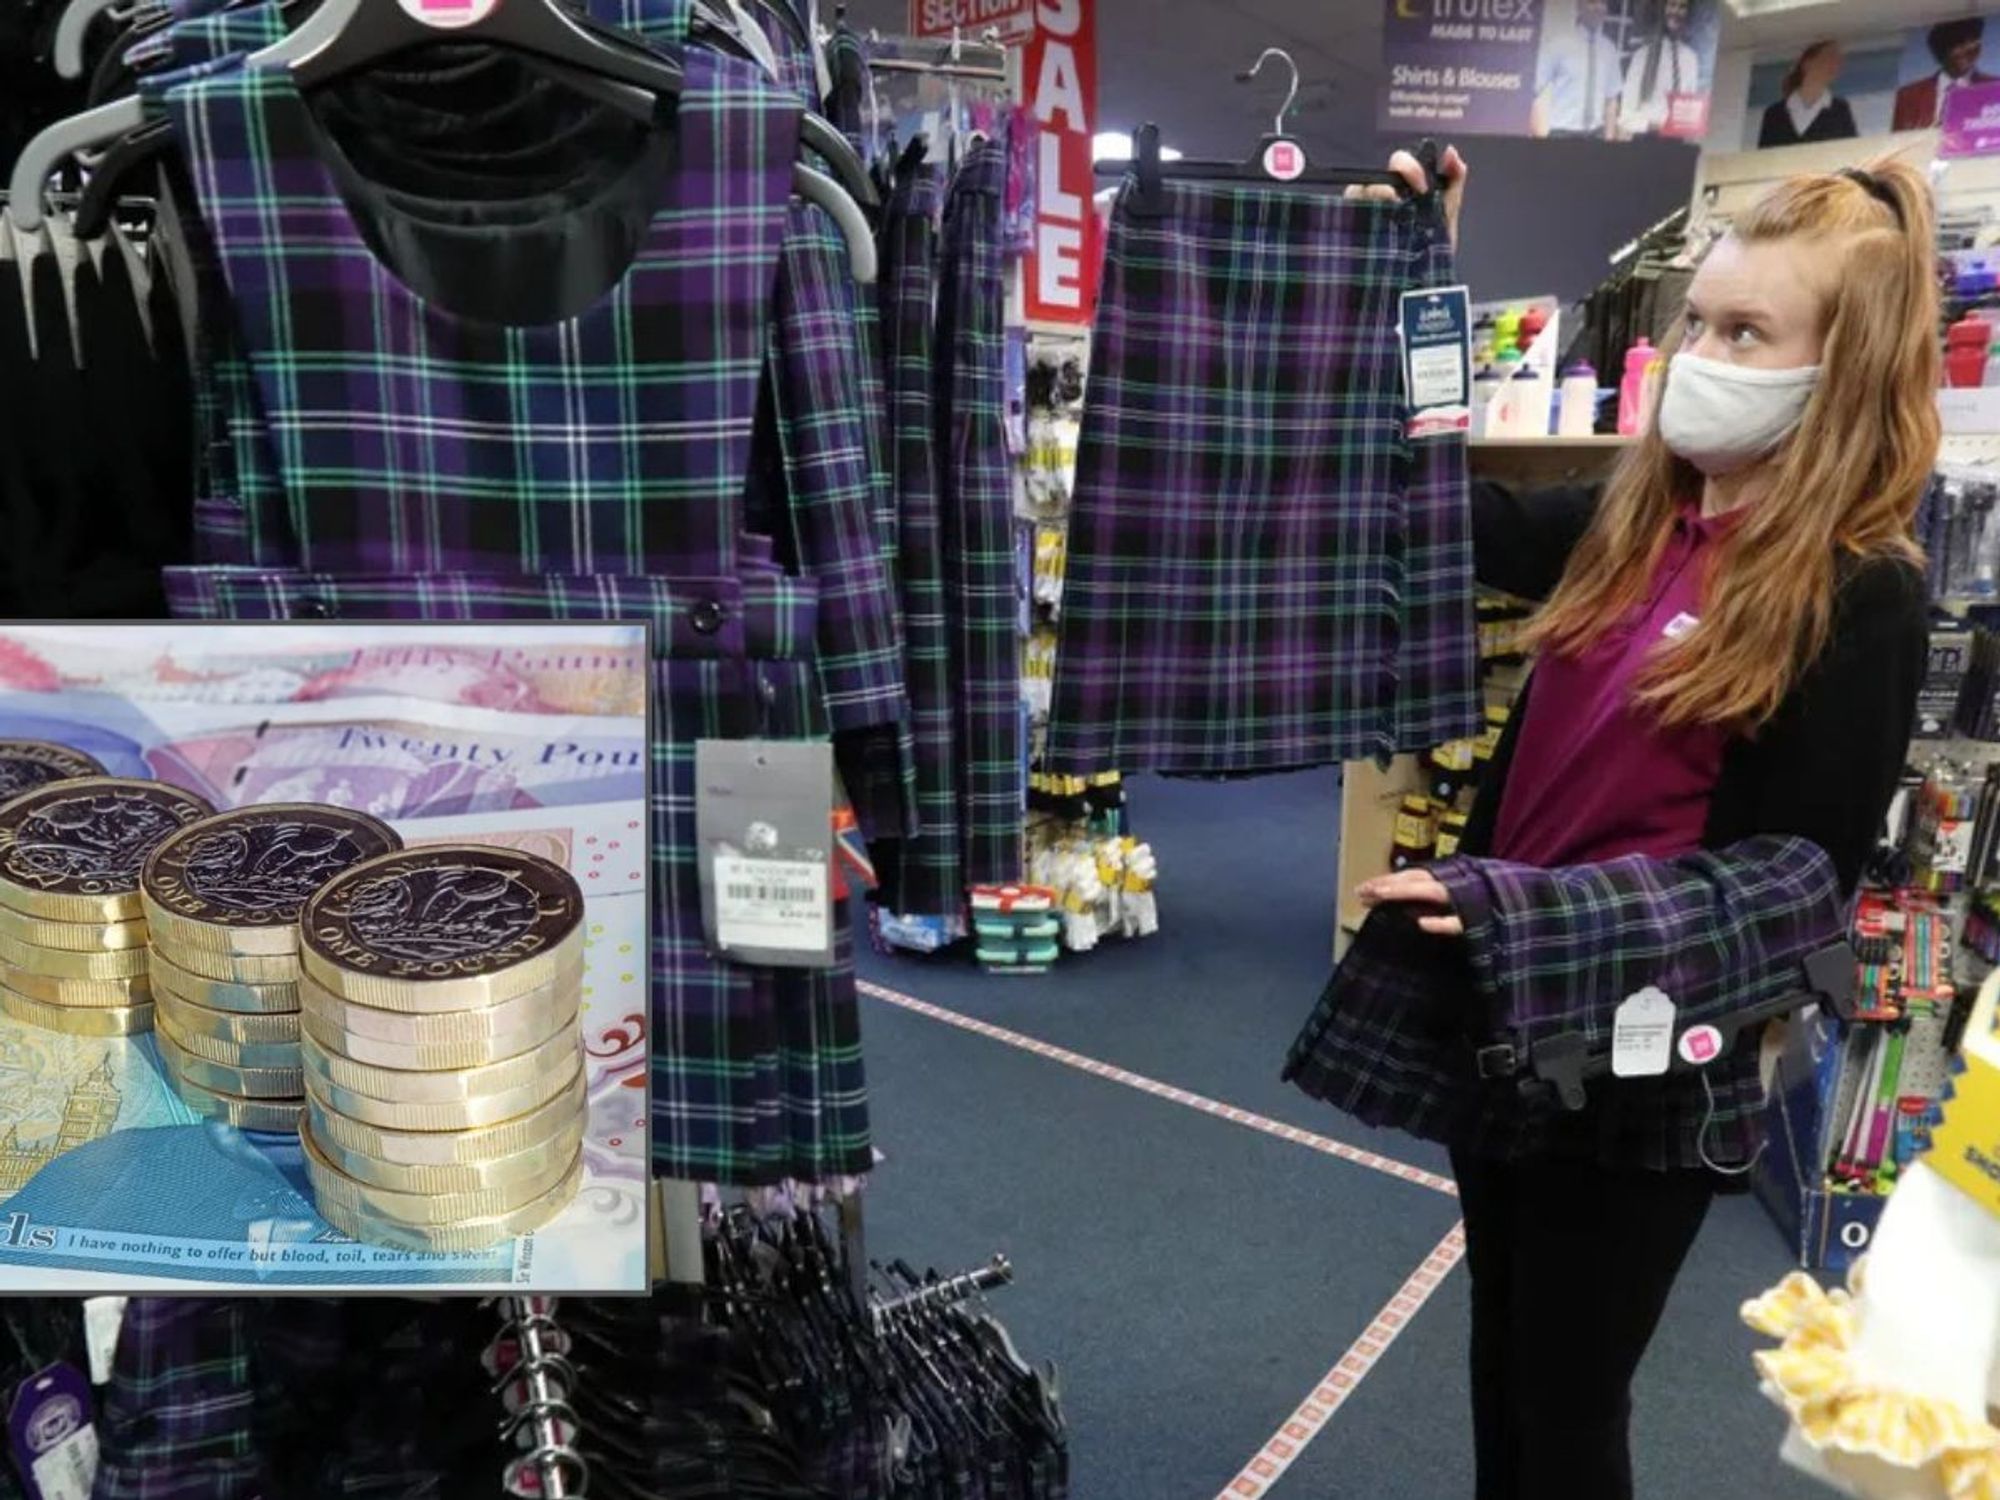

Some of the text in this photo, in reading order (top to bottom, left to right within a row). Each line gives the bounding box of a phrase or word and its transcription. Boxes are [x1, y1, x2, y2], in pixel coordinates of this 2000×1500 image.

[1392, 64, 1521, 90] Shirts & Blouses
[339, 727, 512, 769] Twenty
[318, 925, 547, 976] ONE POUND
[80, 1235, 116, 1250] have
[121, 1240, 182, 1259] nothing
[187, 1244, 203, 1258] to
[208, 1246, 244, 1261] offer
[250, 1248, 276, 1262] but
[281, 1250, 330, 1265] blood,
[336, 1250, 366, 1265] toil,
[372, 1250, 411, 1262] tears
